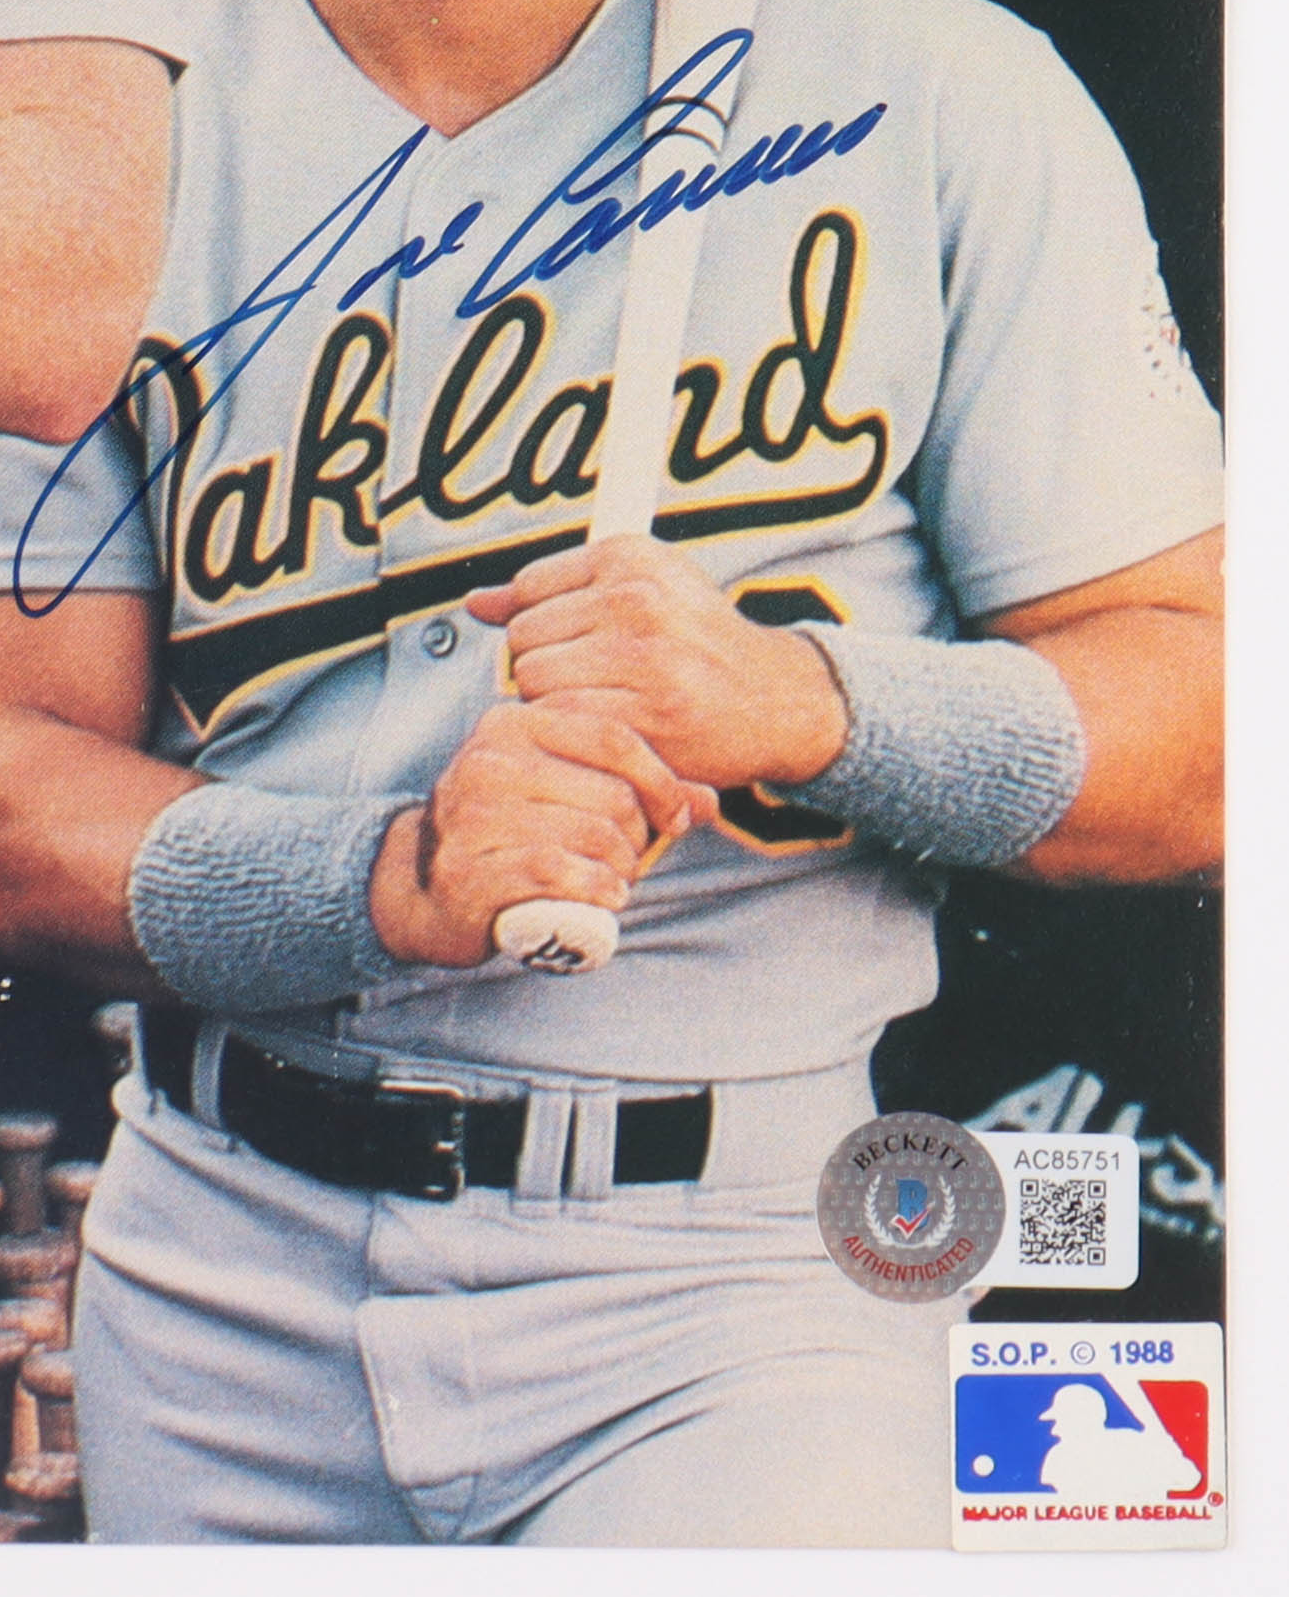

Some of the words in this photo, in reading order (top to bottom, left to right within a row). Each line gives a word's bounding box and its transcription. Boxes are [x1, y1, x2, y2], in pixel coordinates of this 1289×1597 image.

[853, 1132, 969, 1171] BECKETT
[1013, 1149, 1119, 1171] AC85751
[842, 1235, 975, 1283] AUTHENTICATED
[970, 1341, 1057, 1367] S.O.P.
[1110, 1340, 1174, 1365] 1988
[962, 1504, 1028, 1521] MAJOR
[1034, 1505, 1109, 1521] LEAGUE
[1114, 1505, 1213, 1521] BASEBALL
